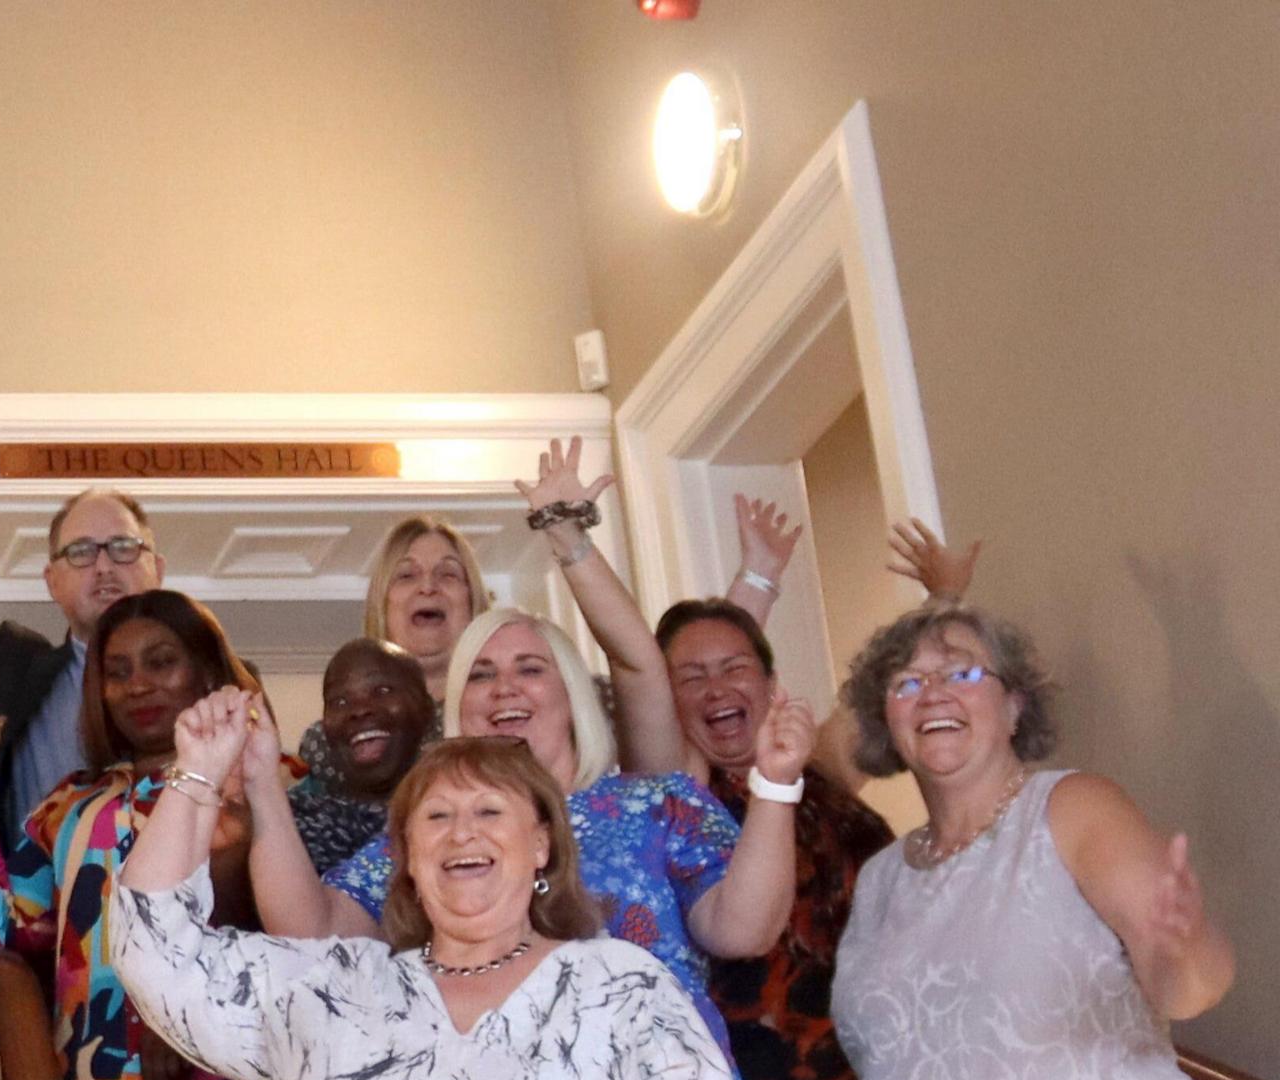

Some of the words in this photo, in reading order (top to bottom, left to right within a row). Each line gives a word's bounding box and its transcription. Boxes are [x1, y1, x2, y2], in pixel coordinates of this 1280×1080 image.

[40, 448, 110, 473] THE
[122, 447, 265, 477] QUEENS
[276, 448, 362, 472] HALL
